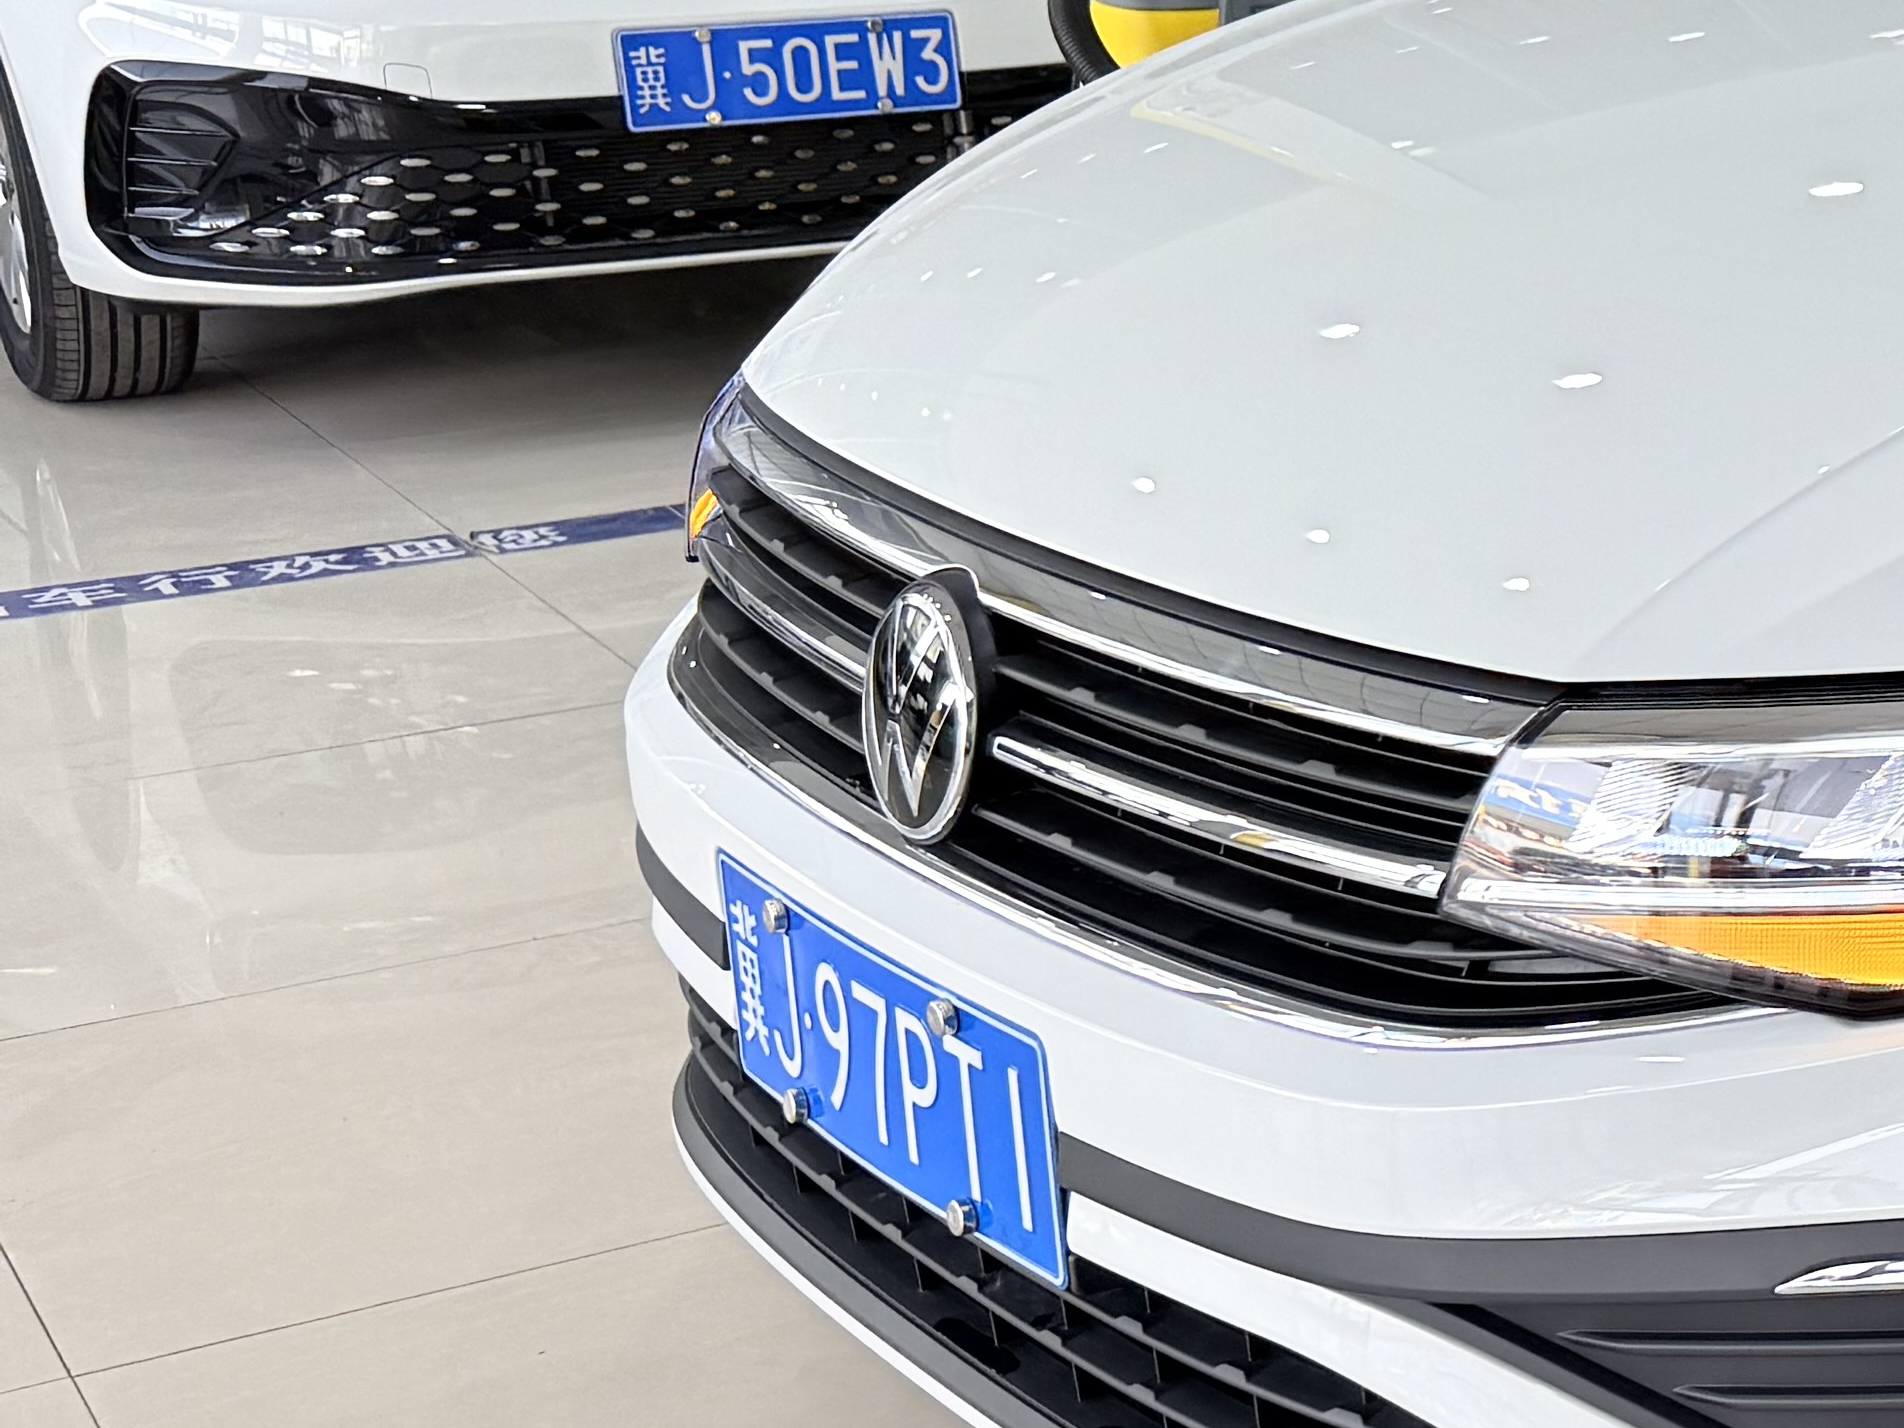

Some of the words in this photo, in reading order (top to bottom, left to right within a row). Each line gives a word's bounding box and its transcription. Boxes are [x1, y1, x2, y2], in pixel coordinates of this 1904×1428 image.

[0, 525, 568, 620] 车行欢迎您
